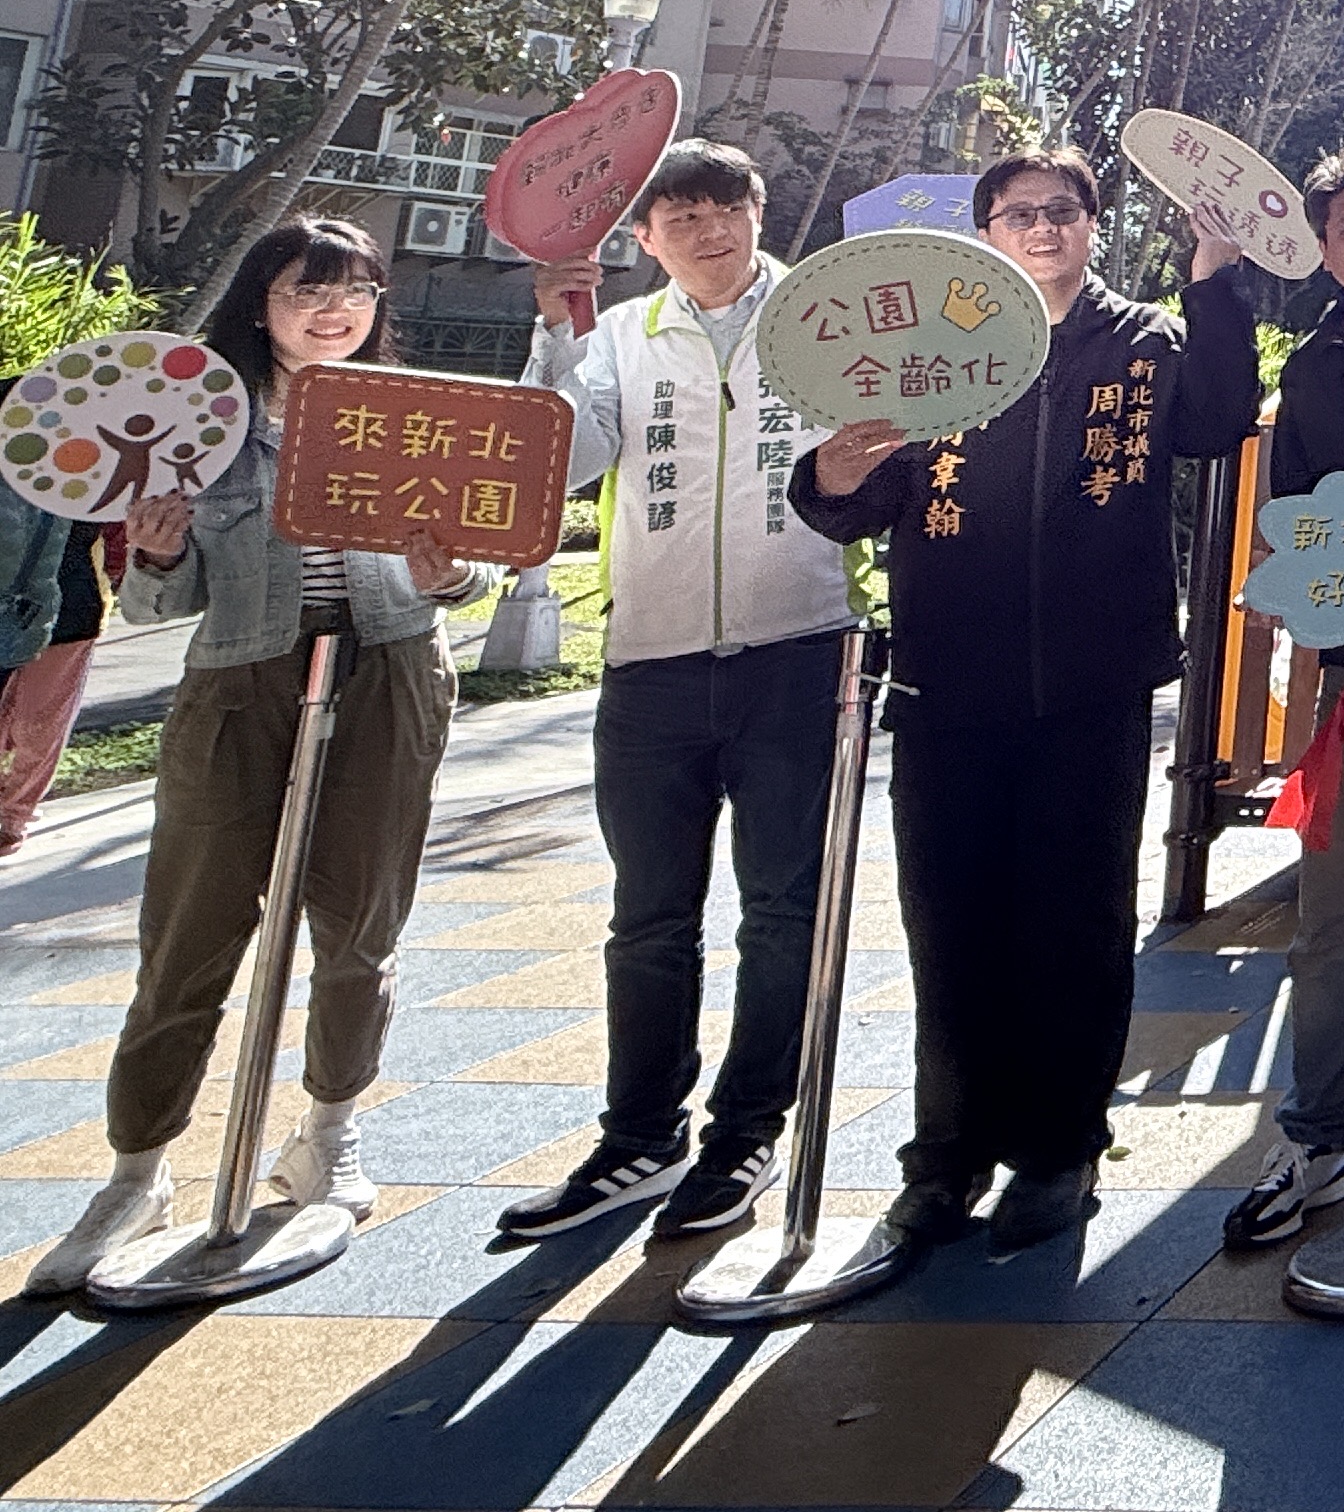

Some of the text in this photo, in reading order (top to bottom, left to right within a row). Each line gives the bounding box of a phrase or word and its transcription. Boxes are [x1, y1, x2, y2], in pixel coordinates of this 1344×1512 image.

[1168, 127, 1244, 187] 親子
[800, 281, 920, 341] 公園
[842, 353, 1008, 398] 全齡化
[334, 406, 526, 464] 來新北
[1079, 383, 1125, 507] 周勝考
[324, 472, 519, 532] 玩公園
